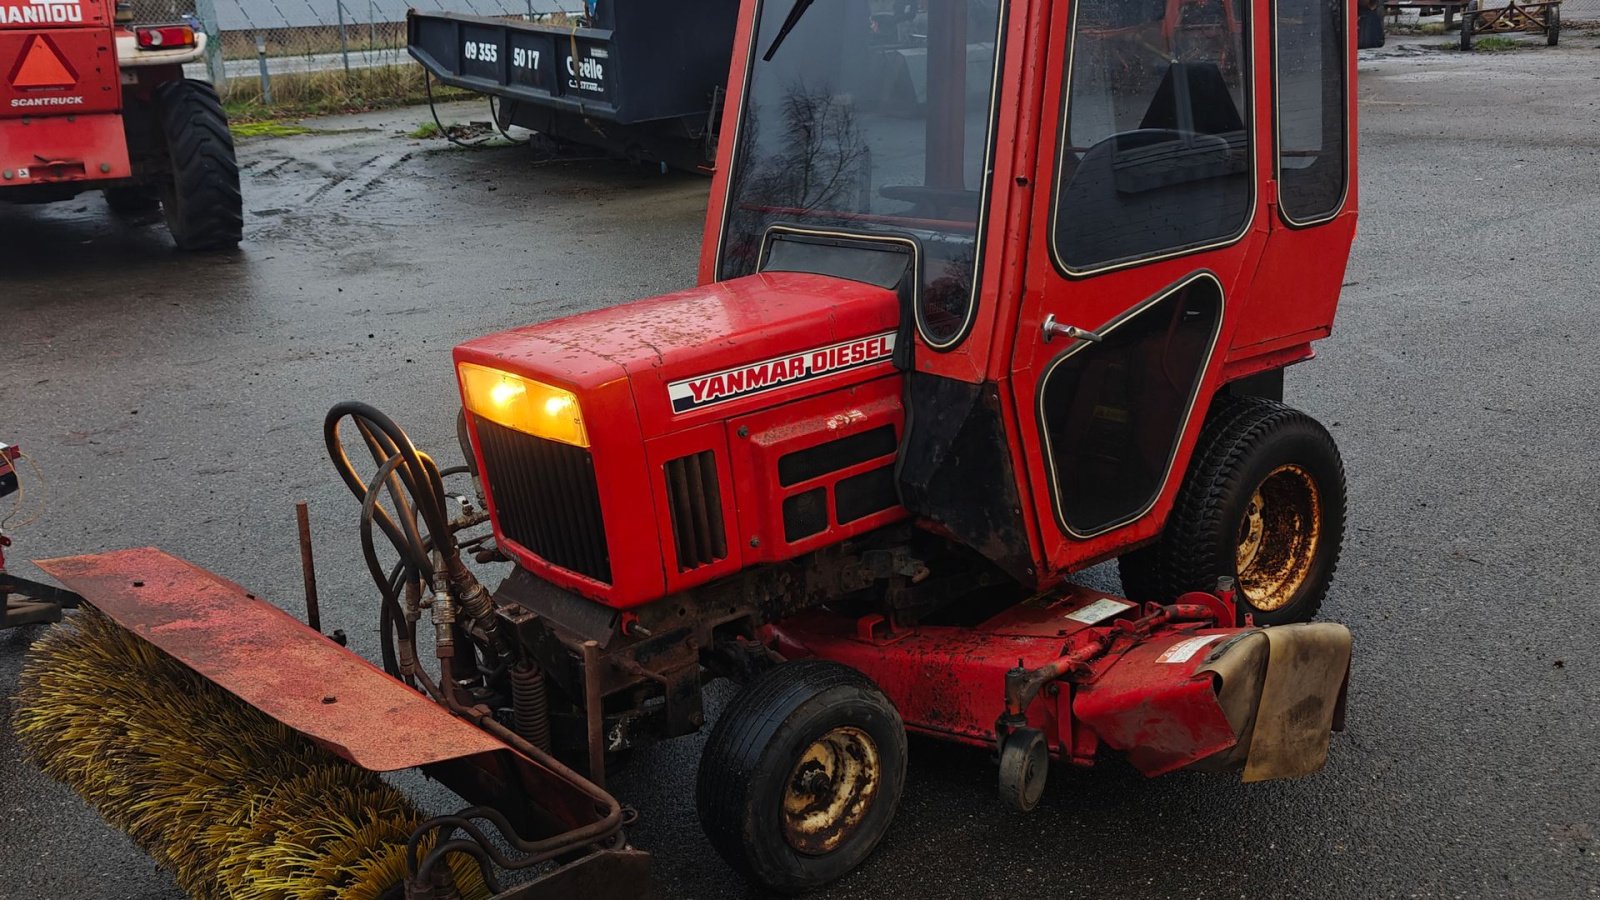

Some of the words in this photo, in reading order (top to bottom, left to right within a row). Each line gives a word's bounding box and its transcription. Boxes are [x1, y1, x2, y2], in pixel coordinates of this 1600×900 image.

[464, 41, 477, 60] 09
[478, 42, 498, 62] 355
[513, 47, 526, 67] 50
[527, 49, 540, 70] 17
[10, 96, 83, 107] SCANTRUCK
[688, 355, 805, 402] YANMAR
[811, 337, 893, 372] DIESEL
